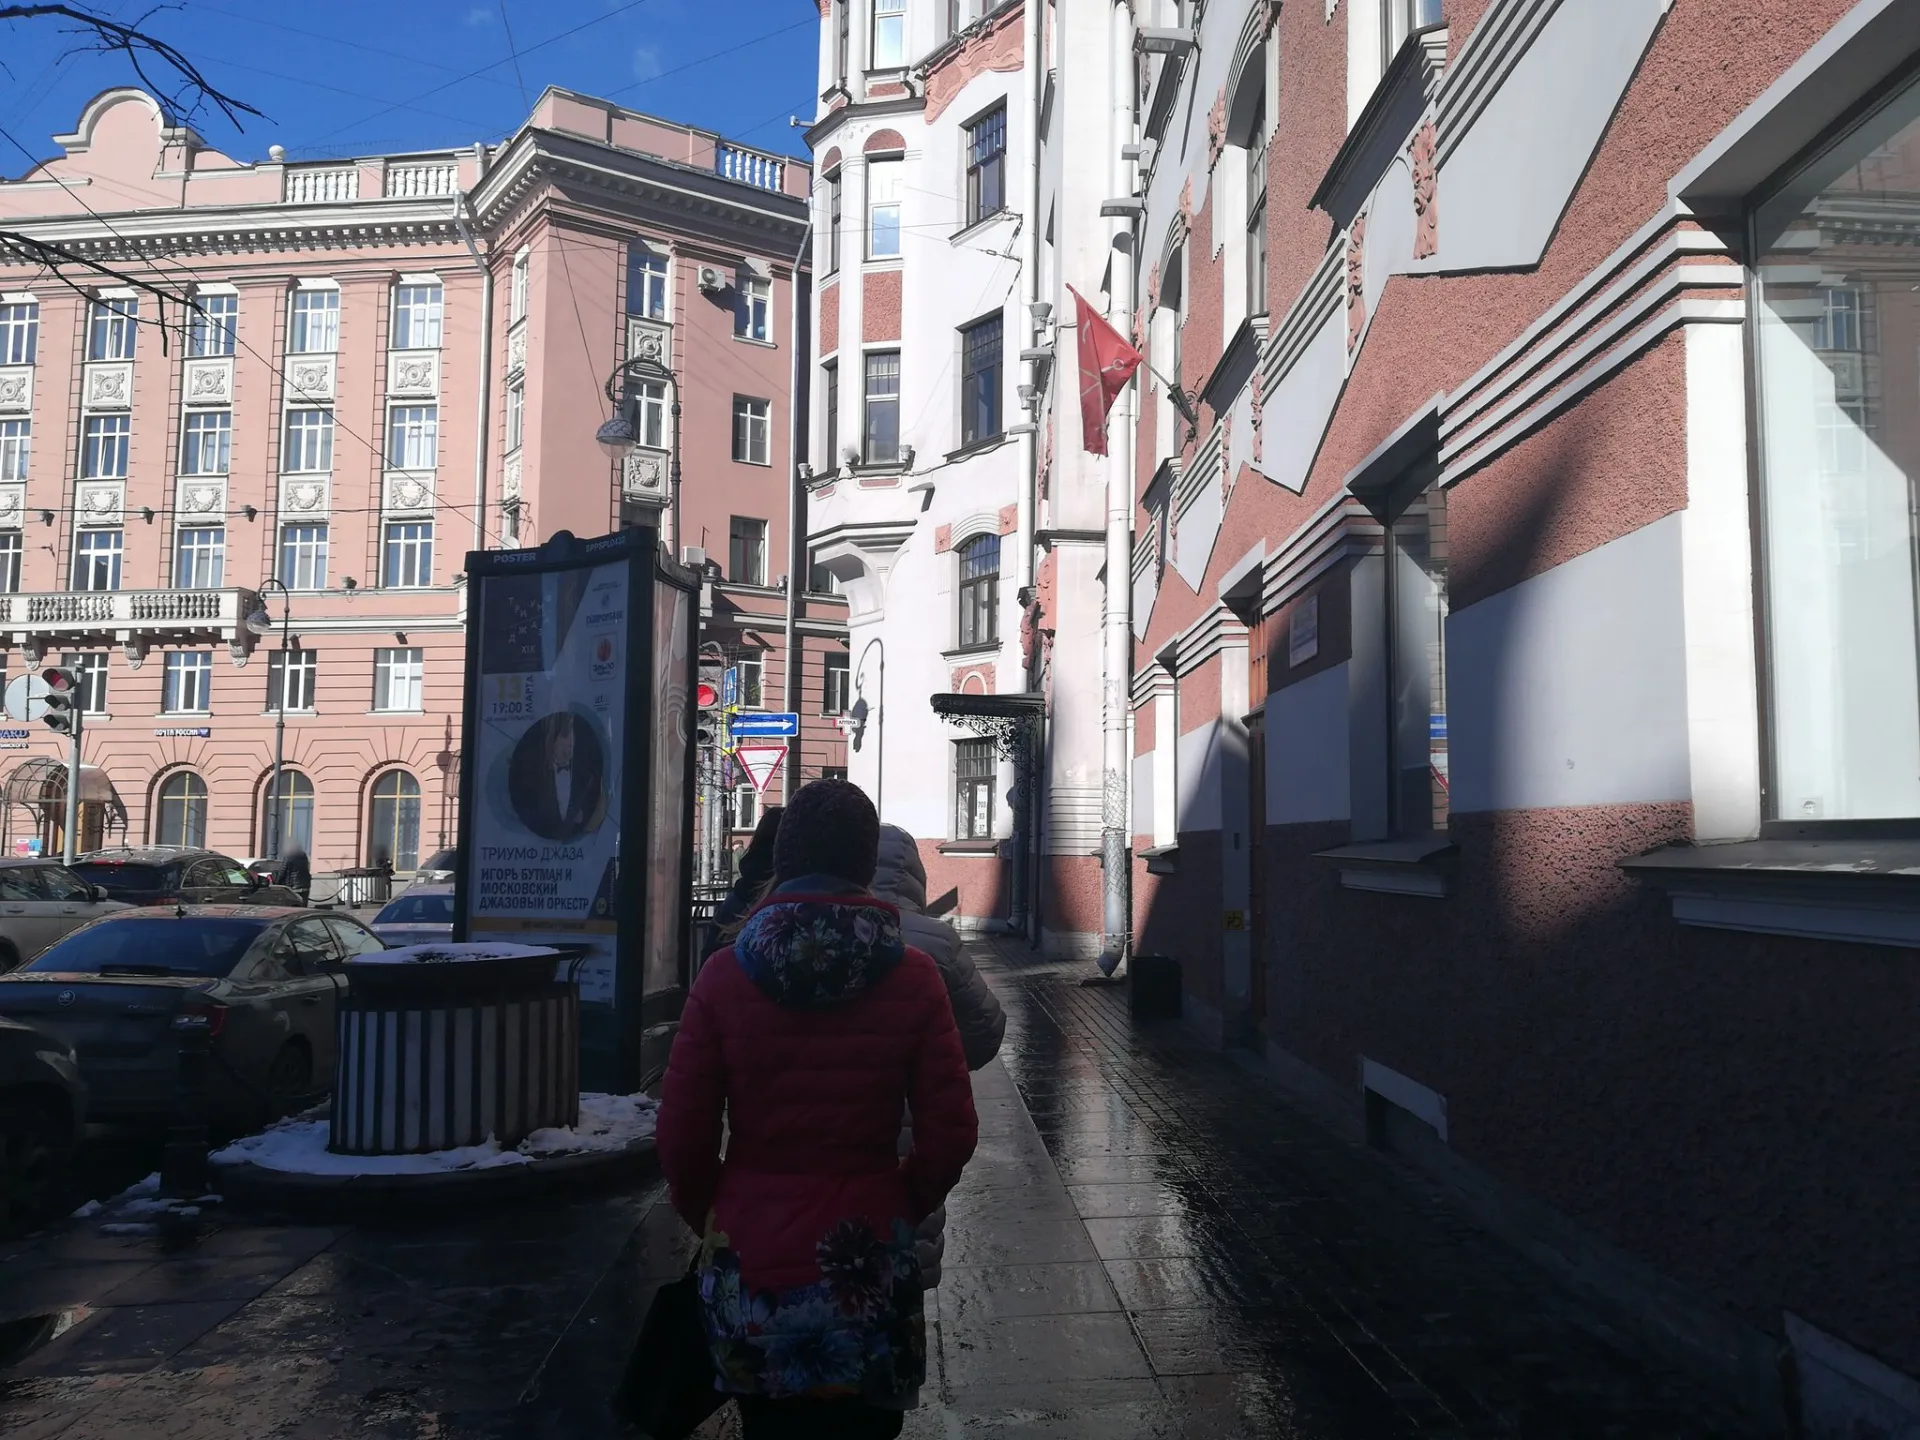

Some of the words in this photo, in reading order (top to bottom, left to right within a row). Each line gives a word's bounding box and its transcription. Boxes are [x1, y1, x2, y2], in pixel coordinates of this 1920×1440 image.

[493, 552, 537, 564] POSTER
[525, 676, 534, 713] МАРТА
[492, 701, 523, 714] 19:00
[481, 847, 538, 860] ТРИУМФ
[540, 847, 584, 863] ДЖАЗА
[481, 868, 518, 881] ИГОРЬ
[521, 868, 563, 881] БУТМАН
[566, 868, 572, 881] И
[480, 881, 558, 895] МОСКОВСКИЙ
[479, 895, 544, 910] ДЖАЗОВЫЙ
[547, 897, 589, 910] ОРКЕСТР
